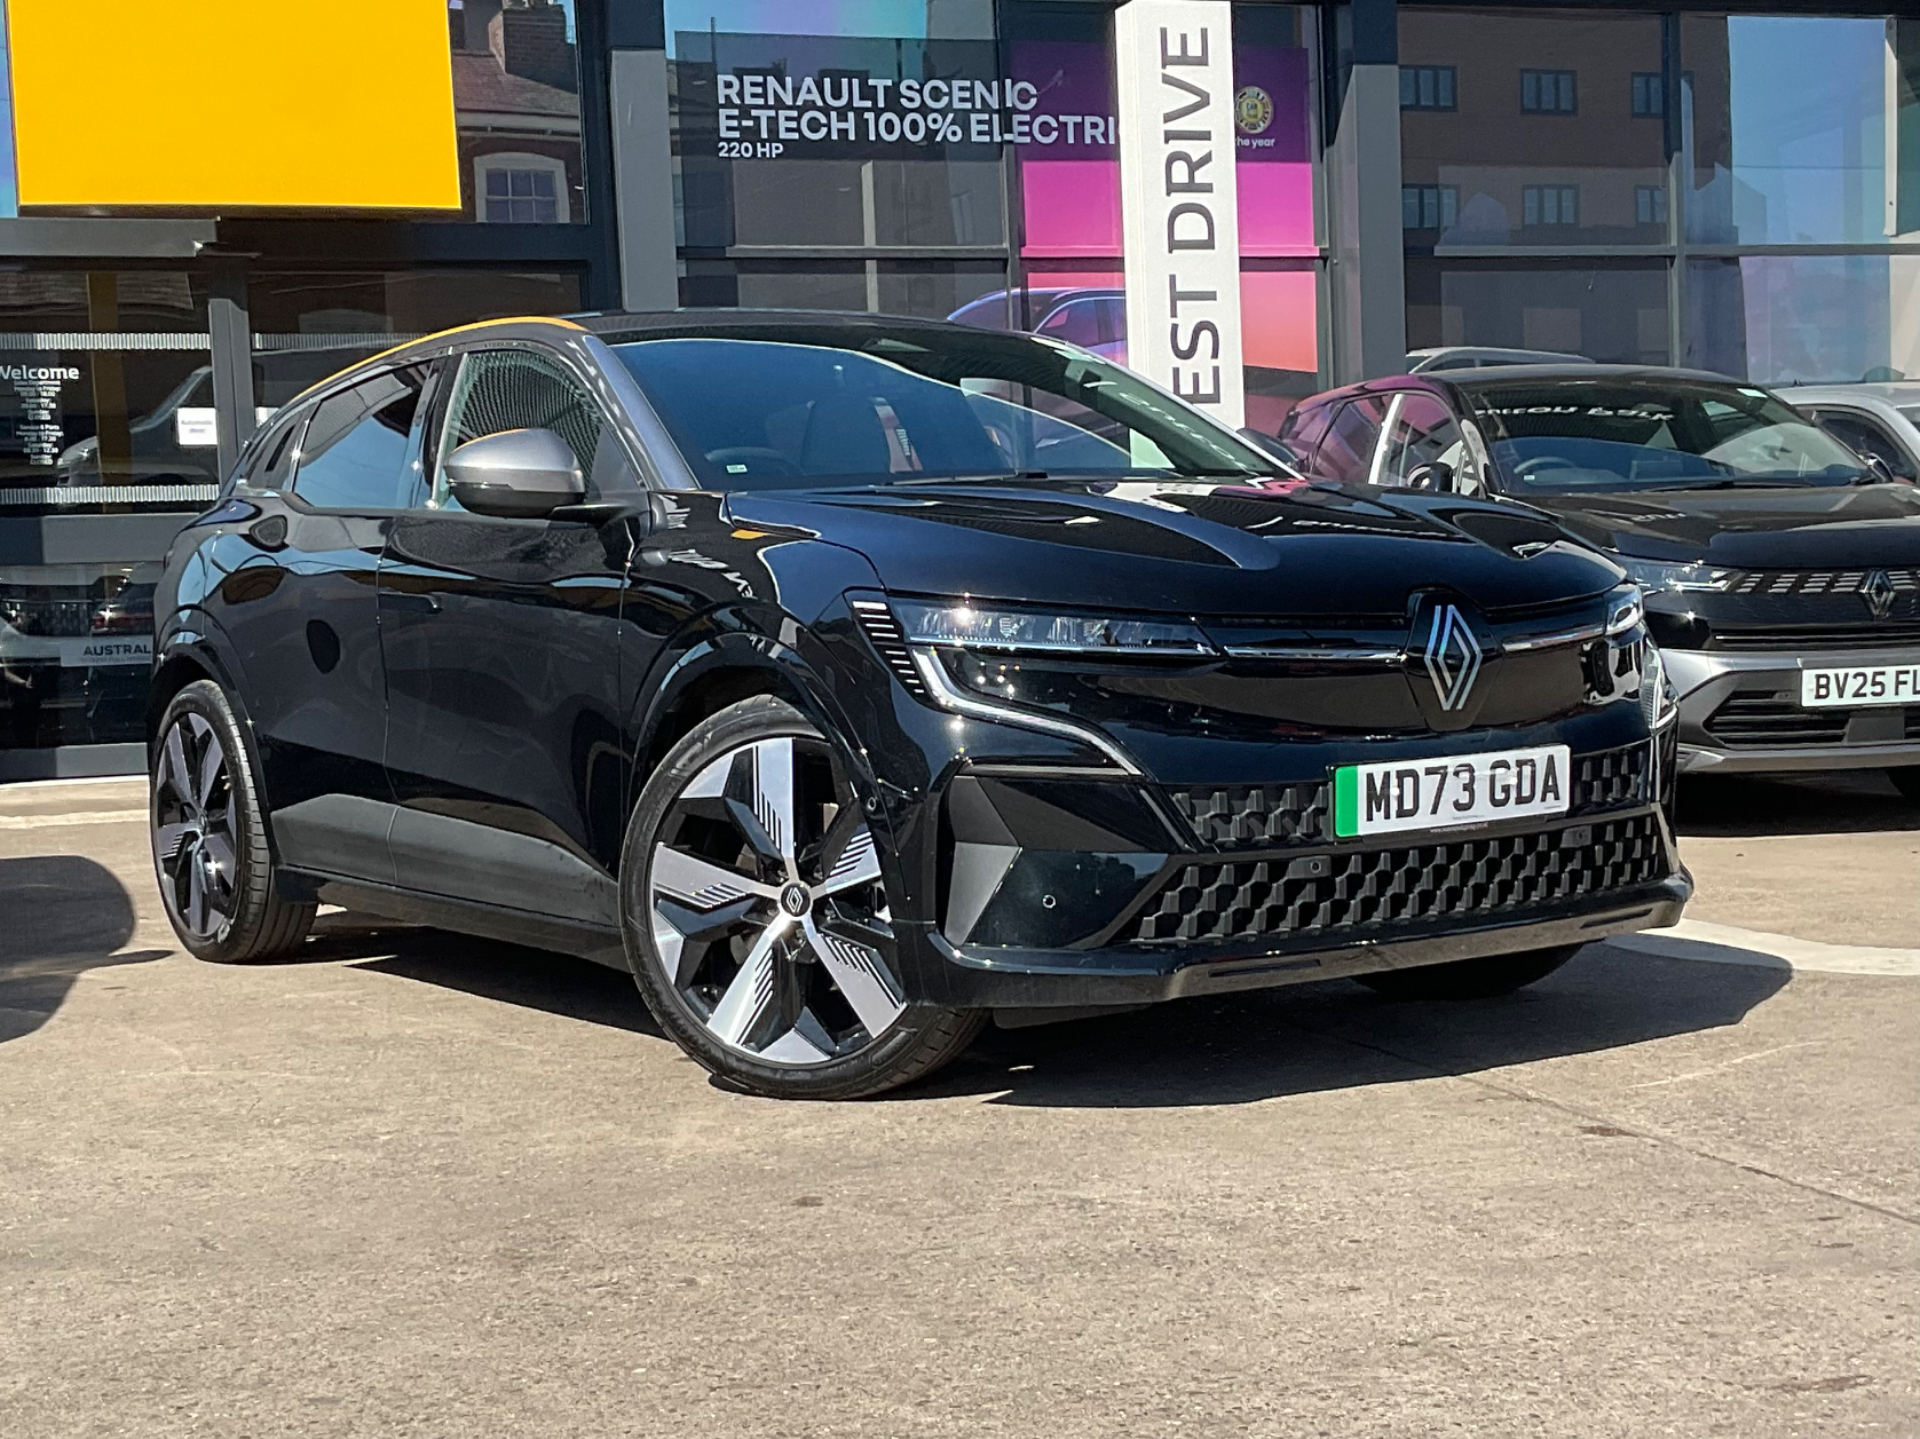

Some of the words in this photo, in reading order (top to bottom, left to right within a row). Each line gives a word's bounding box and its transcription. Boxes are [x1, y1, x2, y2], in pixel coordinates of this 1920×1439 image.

[717, 74, 892, 108] RENAULT
[900, 78, 1038, 110] SCENIC
[718, 108, 856, 141] E-TECH
[863, 111, 963, 142] 100%
[1160, 27, 1215, 254] DRIVE
[718, 142, 753, 157] 220
[757, 142, 784, 158] HP
[1252, 138, 1275, 149] year
[83, 644, 152, 656] AUSTRAL
[1814, 671, 1887, 699] BV25
[1366, 763, 1476, 822] MD73
[1489, 754, 1560, 807] GDA
